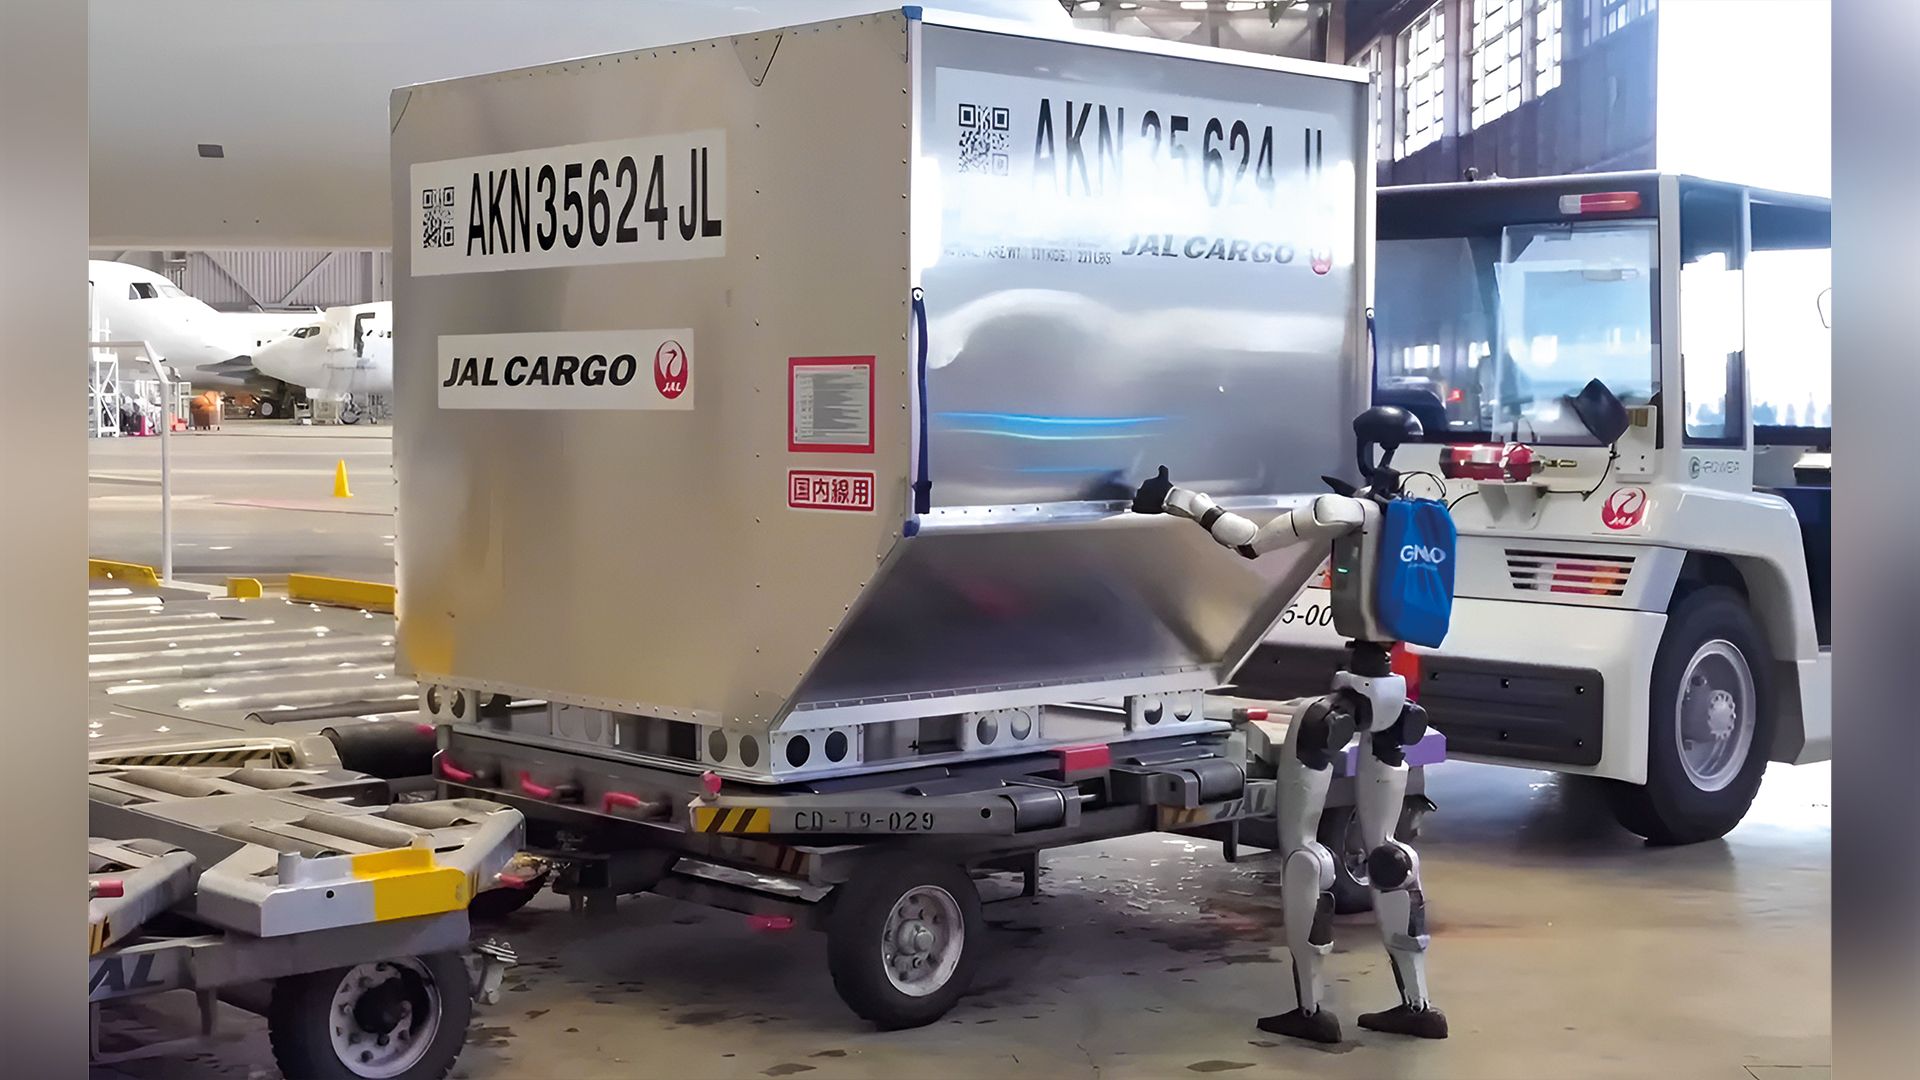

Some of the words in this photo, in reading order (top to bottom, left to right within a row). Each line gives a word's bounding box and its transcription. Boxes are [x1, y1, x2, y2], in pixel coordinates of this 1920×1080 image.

[679, 147, 722, 242] JL
[1121, 234, 1178, 258] JAL
[1183, 236, 1295, 264] CARGO
[443, 357, 499, 388] JAL
[503, 353, 637, 388] CARGO
